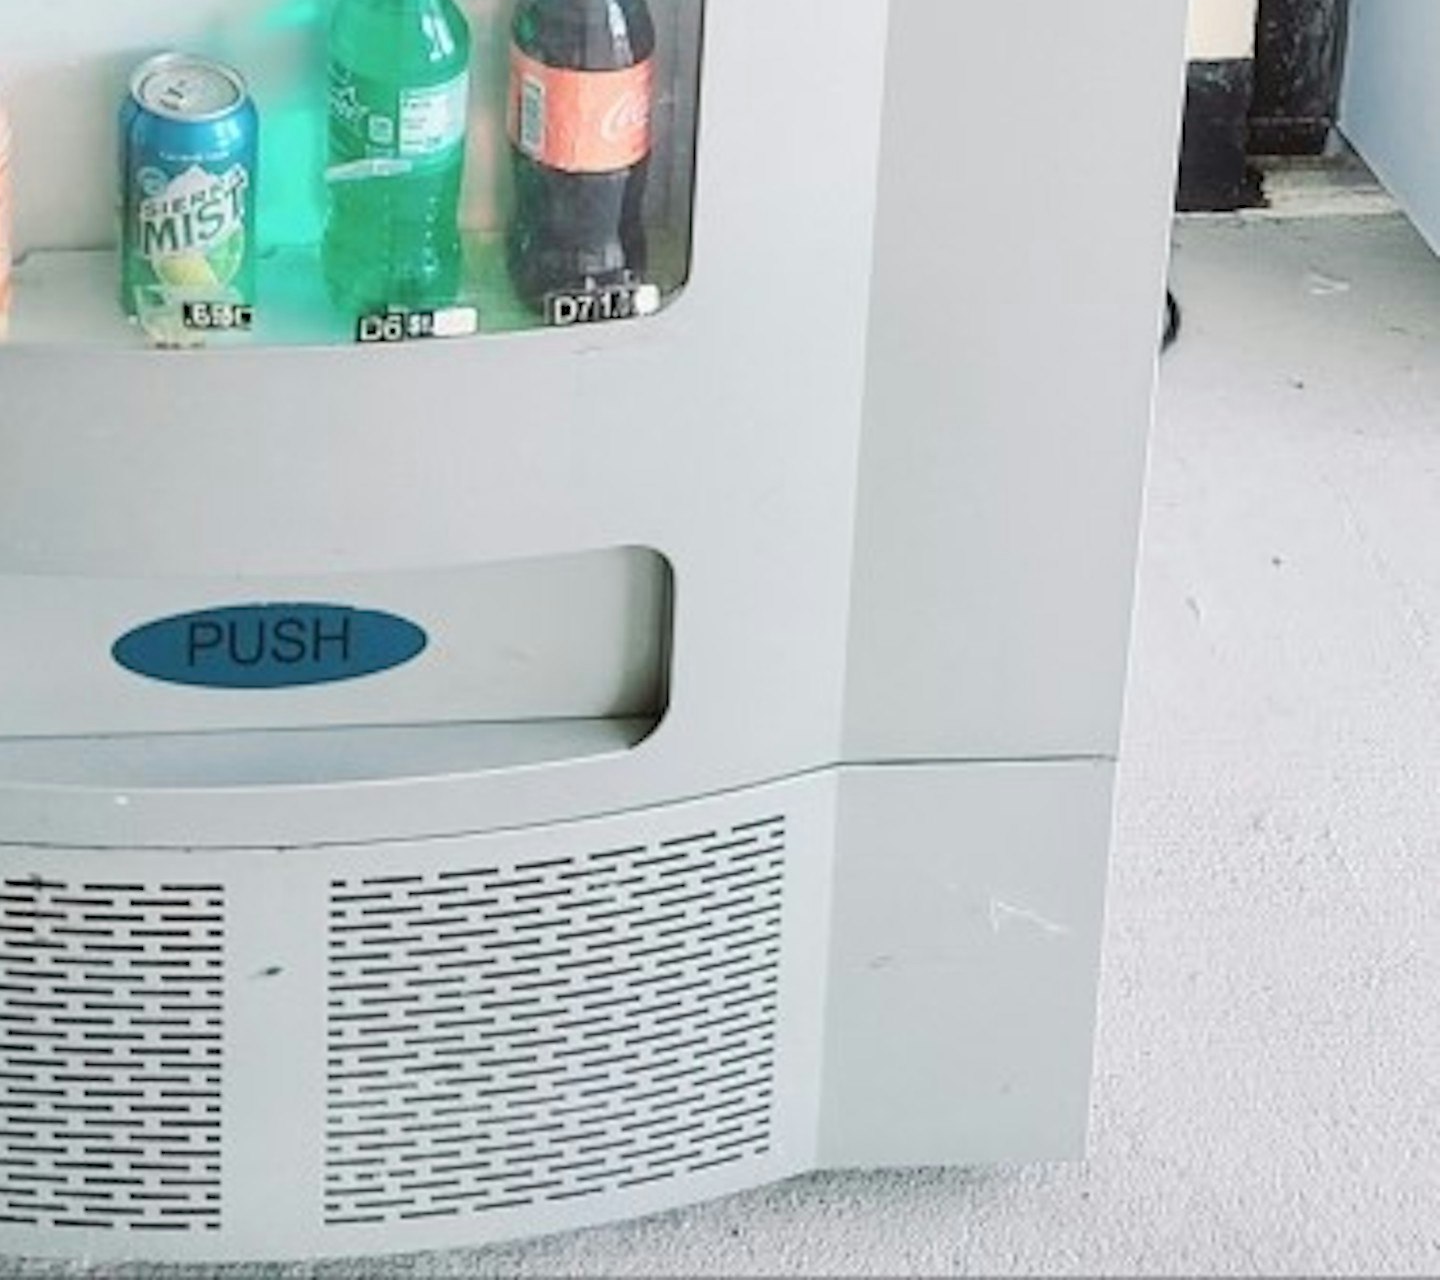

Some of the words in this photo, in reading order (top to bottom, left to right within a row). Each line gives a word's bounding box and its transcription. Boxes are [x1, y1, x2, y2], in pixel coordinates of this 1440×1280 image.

[143, 187, 242, 256] MIST
[360, 316, 402, 342] D6
[553, 295, 594, 325] D7
[186, 616, 351, 667] PUSH
